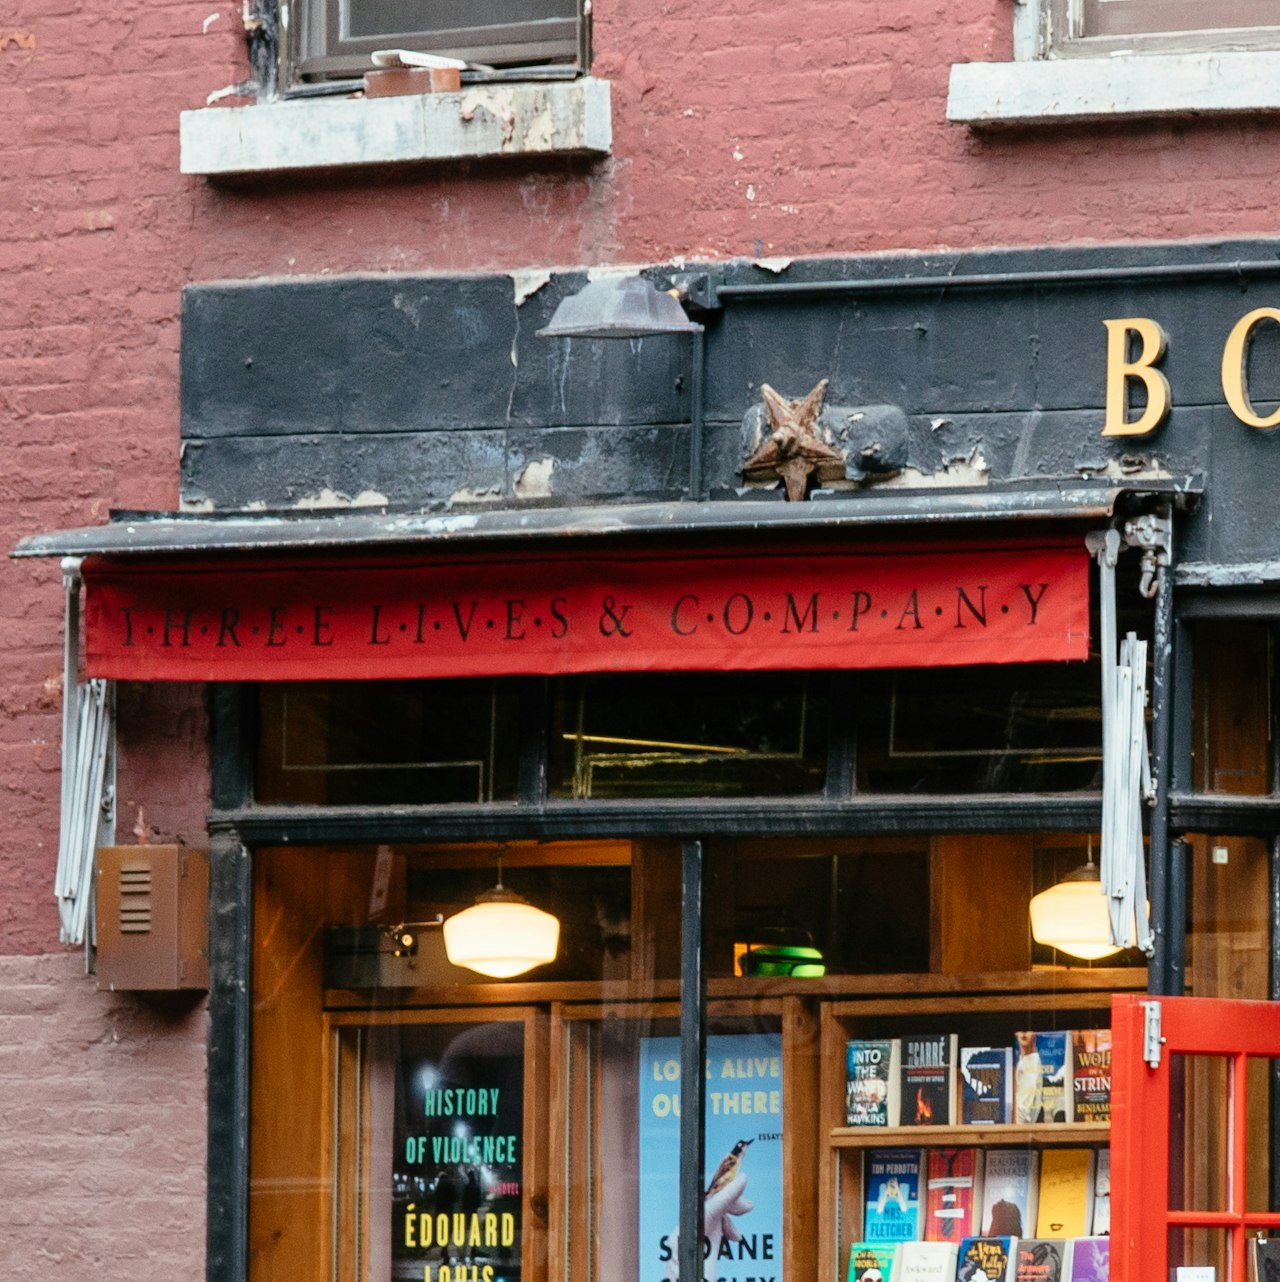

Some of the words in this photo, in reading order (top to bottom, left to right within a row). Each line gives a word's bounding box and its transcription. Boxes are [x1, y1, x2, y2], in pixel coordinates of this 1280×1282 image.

[600, 595, 633, 640] &
[721, 1057, 780, 1079] ALIVE
[851, 1049, 882, 1065] INTO
[854, 1065, 878, 1079] THE
[424, 1087, 500, 1117] HISTORY
[652, 1093, 682, 1118] OU
[710, 1091, 780, 1116] THERE
[405, 1136, 427, 1165] OF
[432, 1135, 517, 1165] VIOLENCE
[404, 1202, 515, 1249] ÉDOUARD
[871, 1222, 913, 1238] FLETCHER
[658, 1233, 775, 1263] SOANE
